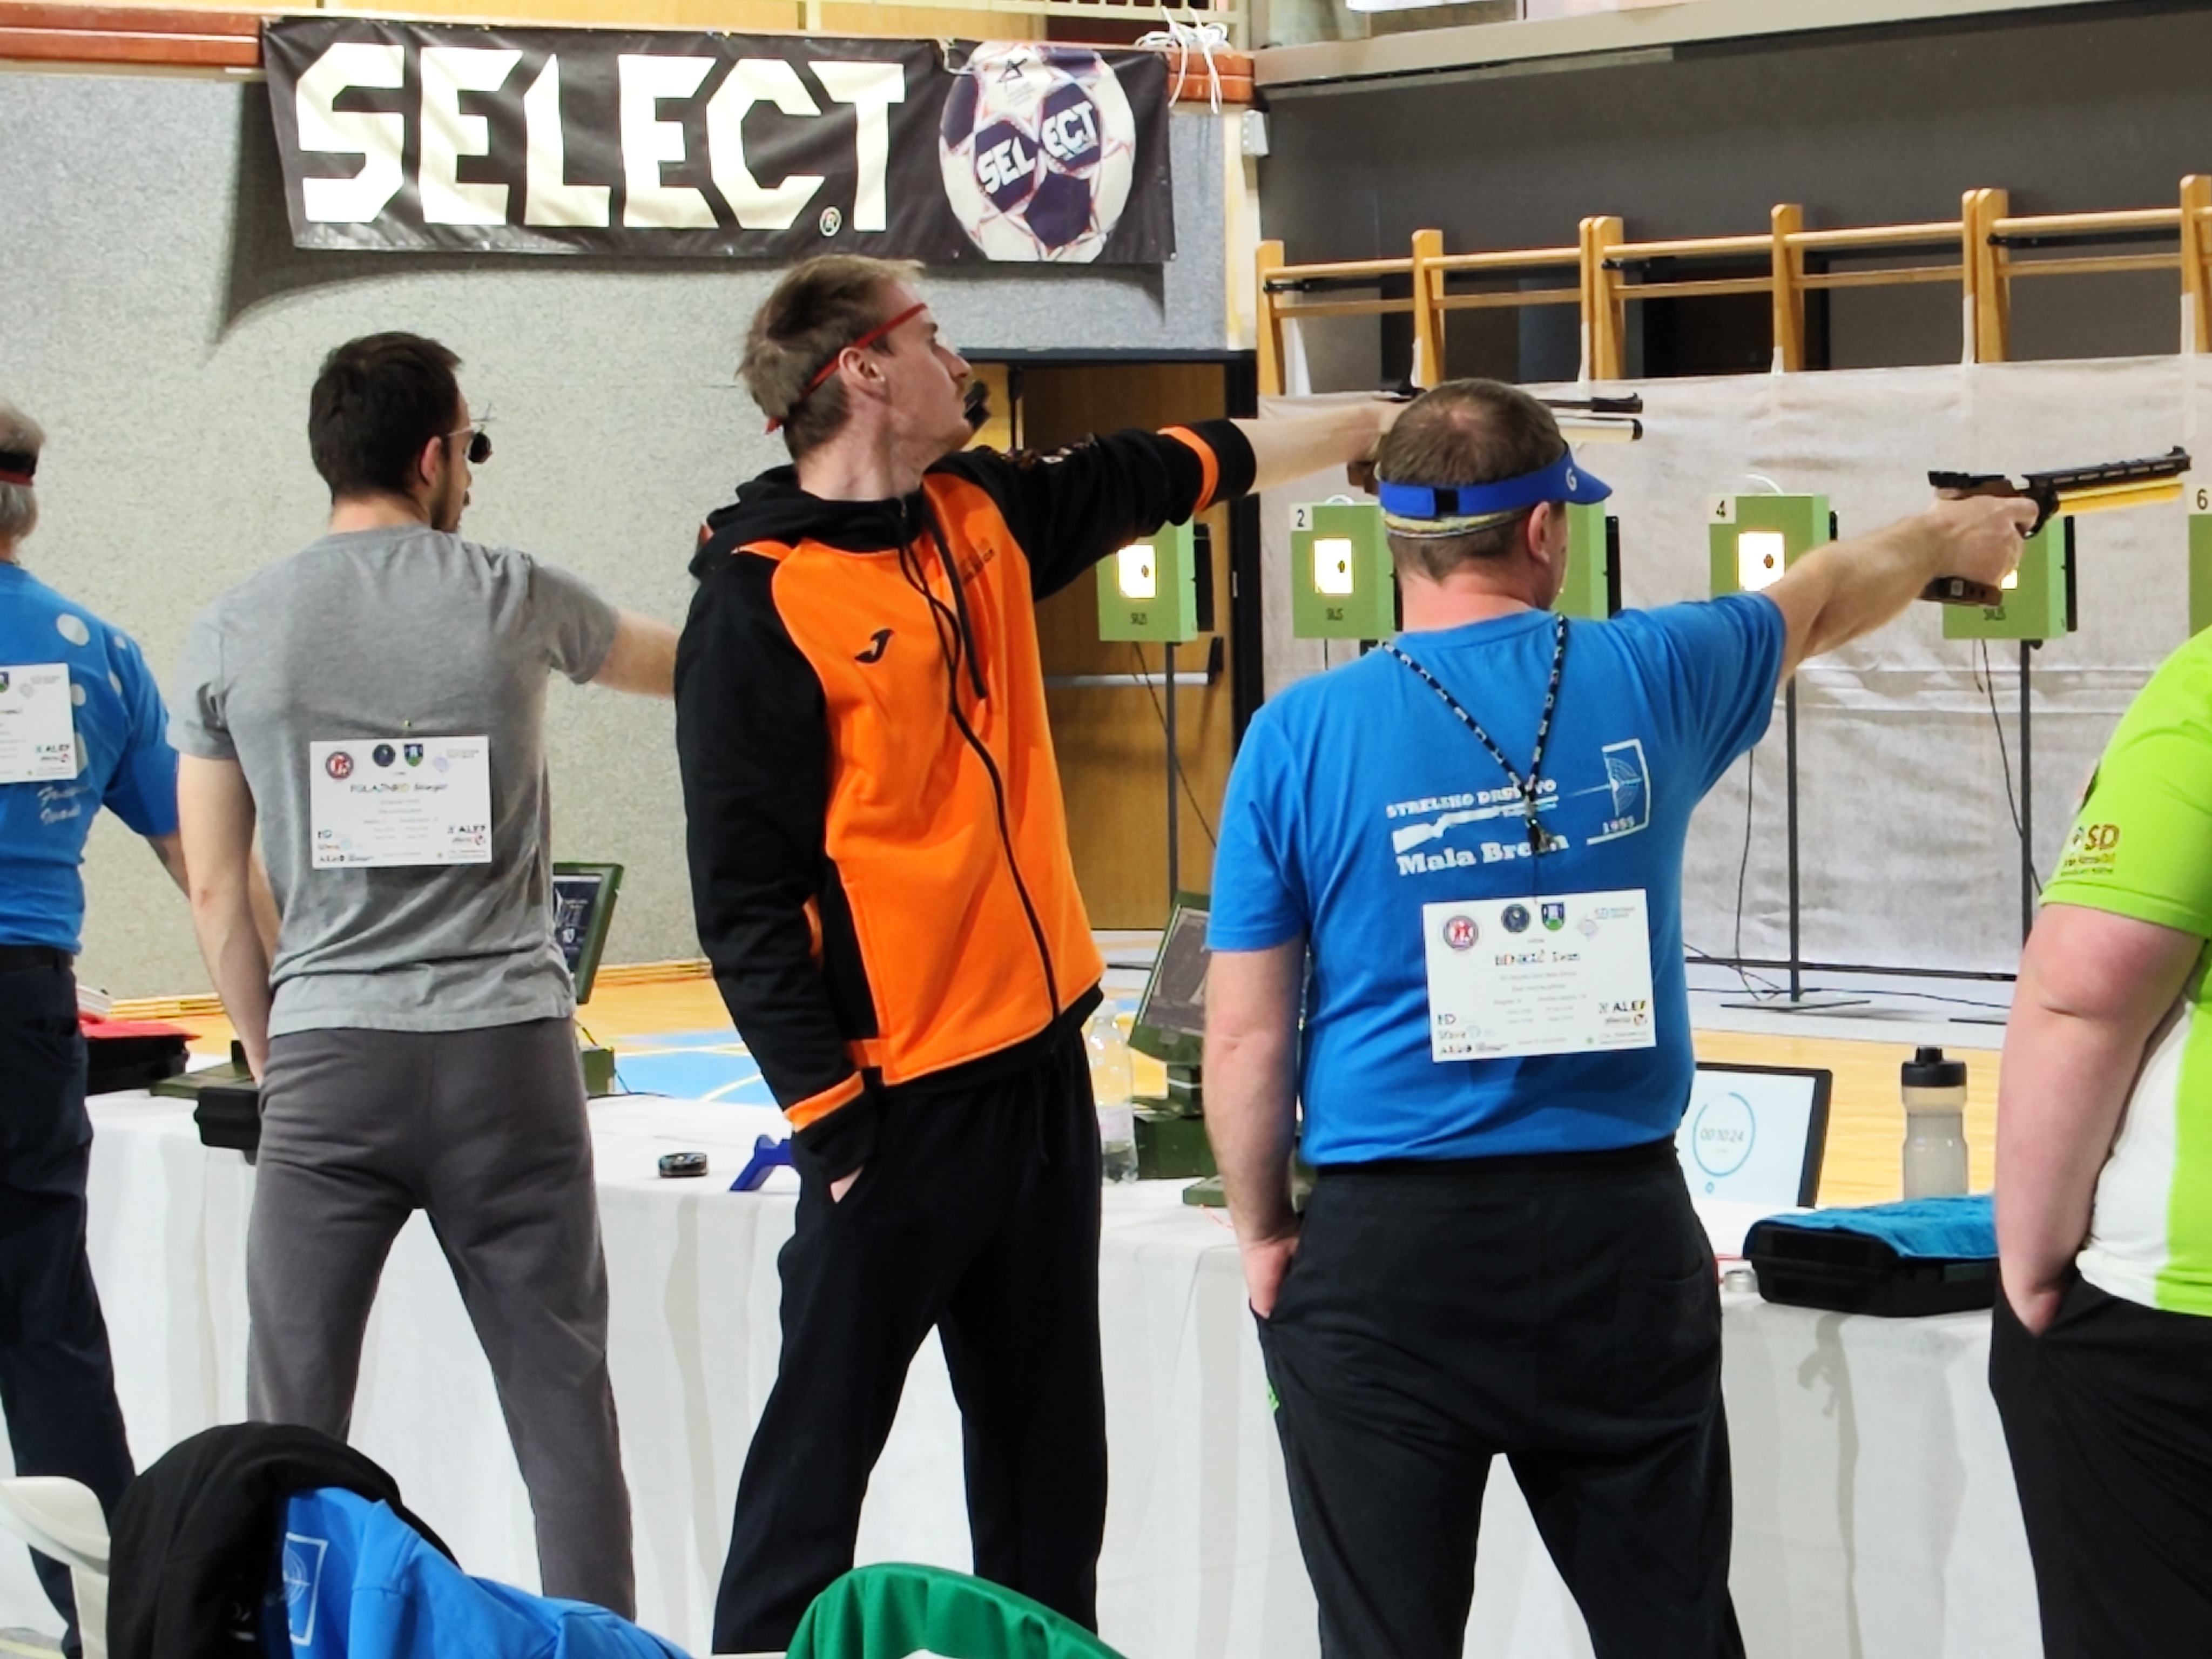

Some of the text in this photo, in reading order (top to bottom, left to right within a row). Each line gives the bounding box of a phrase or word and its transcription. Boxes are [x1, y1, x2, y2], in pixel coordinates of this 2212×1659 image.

[294, 42, 907, 231] SELECT
[976, 101, 1100, 194] SEL ECT
[1716, 500, 1727, 518] 4
[2196, 488, 2208, 510] 6
[1297, 509, 1305, 527] 2
[1397, 835, 1570, 876] Mala Brea
